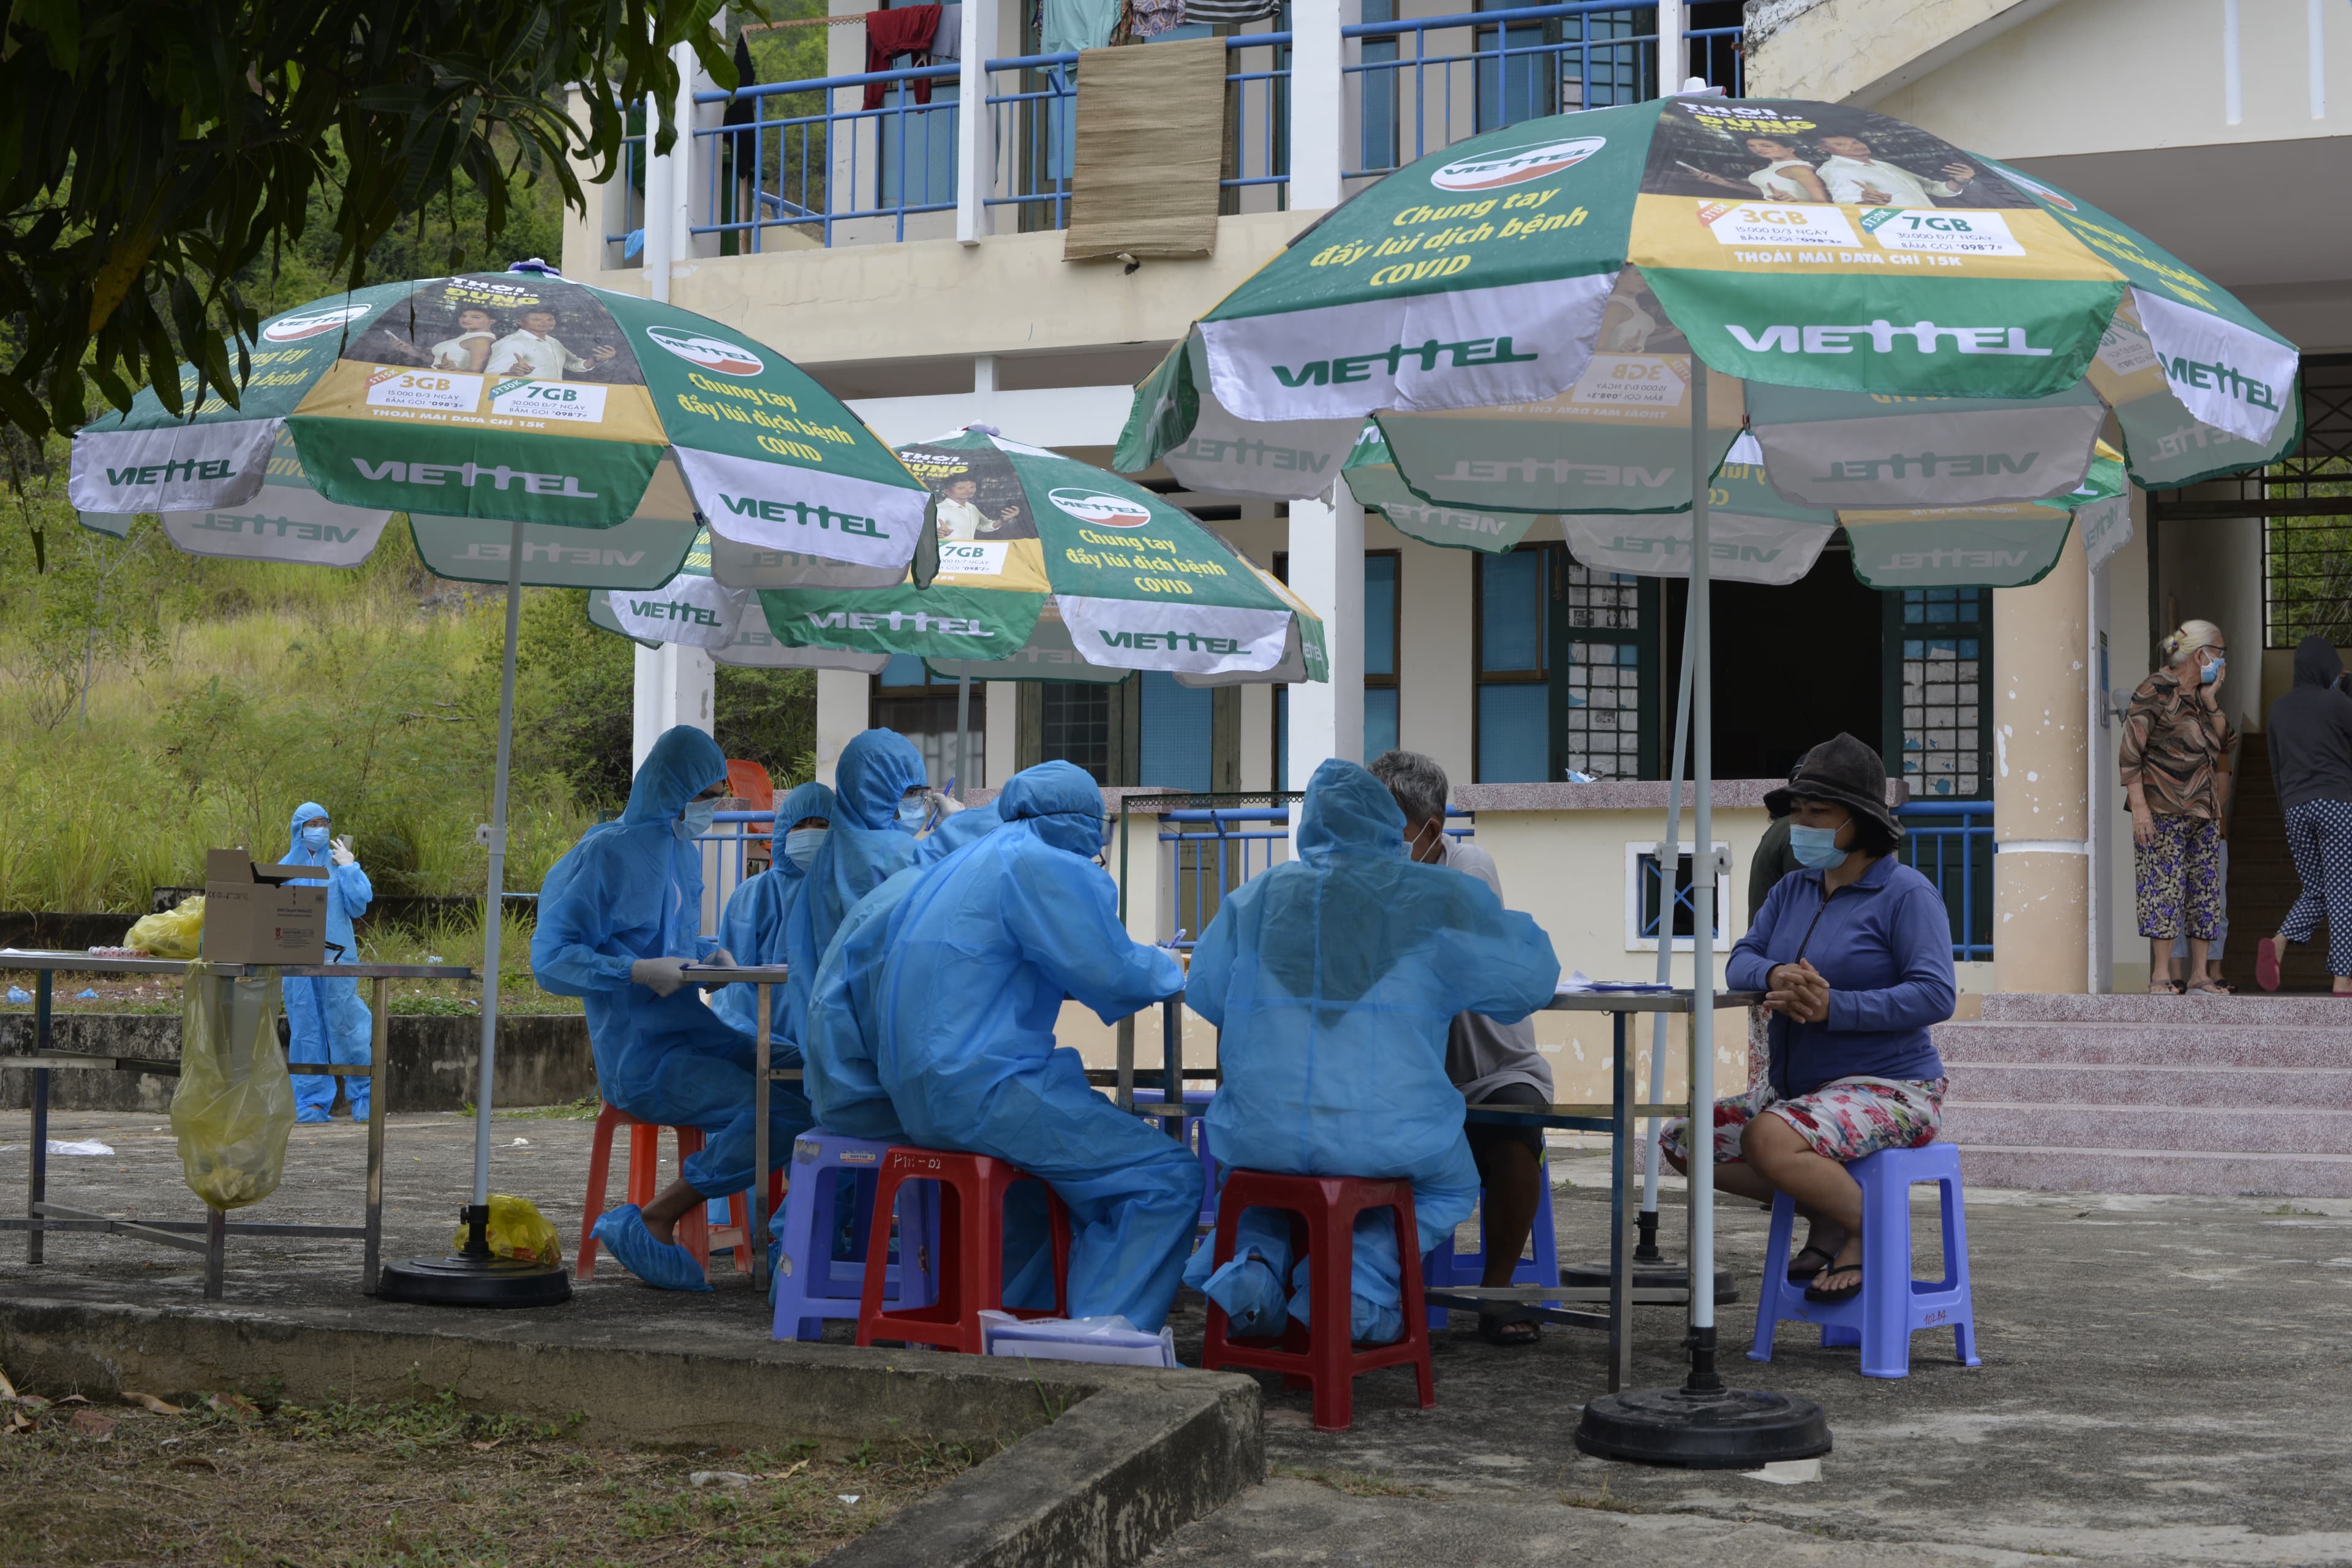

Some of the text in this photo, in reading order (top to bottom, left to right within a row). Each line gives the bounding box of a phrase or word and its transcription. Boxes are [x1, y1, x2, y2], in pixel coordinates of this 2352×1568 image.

[1443, 148, 1596, 175] VIETTEL
[1393, 187, 1562, 226] Chung tay
[1739, 208, 1809, 225] 3GB
[1862, 208, 1892, 228] ST30K
[1310, 206, 1589, 267] đẩy lùi dịch bệnh
[1735, 225, 1770, 234] 15.000
[1901, 216, 1973, 232] 7GB
[1369, 254, 1472, 287] COVID
[1839, 252, 1885, 264] DATA
[1926, 255, 1963, 267] 15K
[651, 336, 758, 363] VIETTEL
[1724, 318, 2053, 356] VIETTEL
[276, 348, 314, 365] tay
[1271, 336, 1538, 388] VIETTEL
[255, 368, 309, 390] bệnh
[369, 368, 399, 385] ST15K
[399, 375, 451, 391] 3GB
[491, 379, 523, 395] ST30K
[2157, 351, 2279, 413] VIETTEL
[527, 386, 578, 402] 7GB
[688, 372, 798, 413] Chung tay
[451, 415, 486, 424] DATA
[519, 420, 546, 428] 15K
[677, 393, 856, 446] đẩy lùi dịch bệnh
[756, 434, 823, 462] COVID
[105, 458, 237, 486] VIETTEL
[351, 457, 598, 499] VIETTEL
[718, 492, 890, 540] VIETTEL
[1052, 499, 1147, 514] VIETTEL
[944, 546, 984, 557] 7GB
[1079, 529, 1177, 554] Chung tay
[1066, 548, 1227, 578] đẩy lùi dịch bệnh
[1133, 576, 1194, 595] COVID
[629, 599, 722, 627] VIETTEL
[804, 610, 995, 638] VIETTEL
[1098, 630, 1253, 655] VIETTEL
